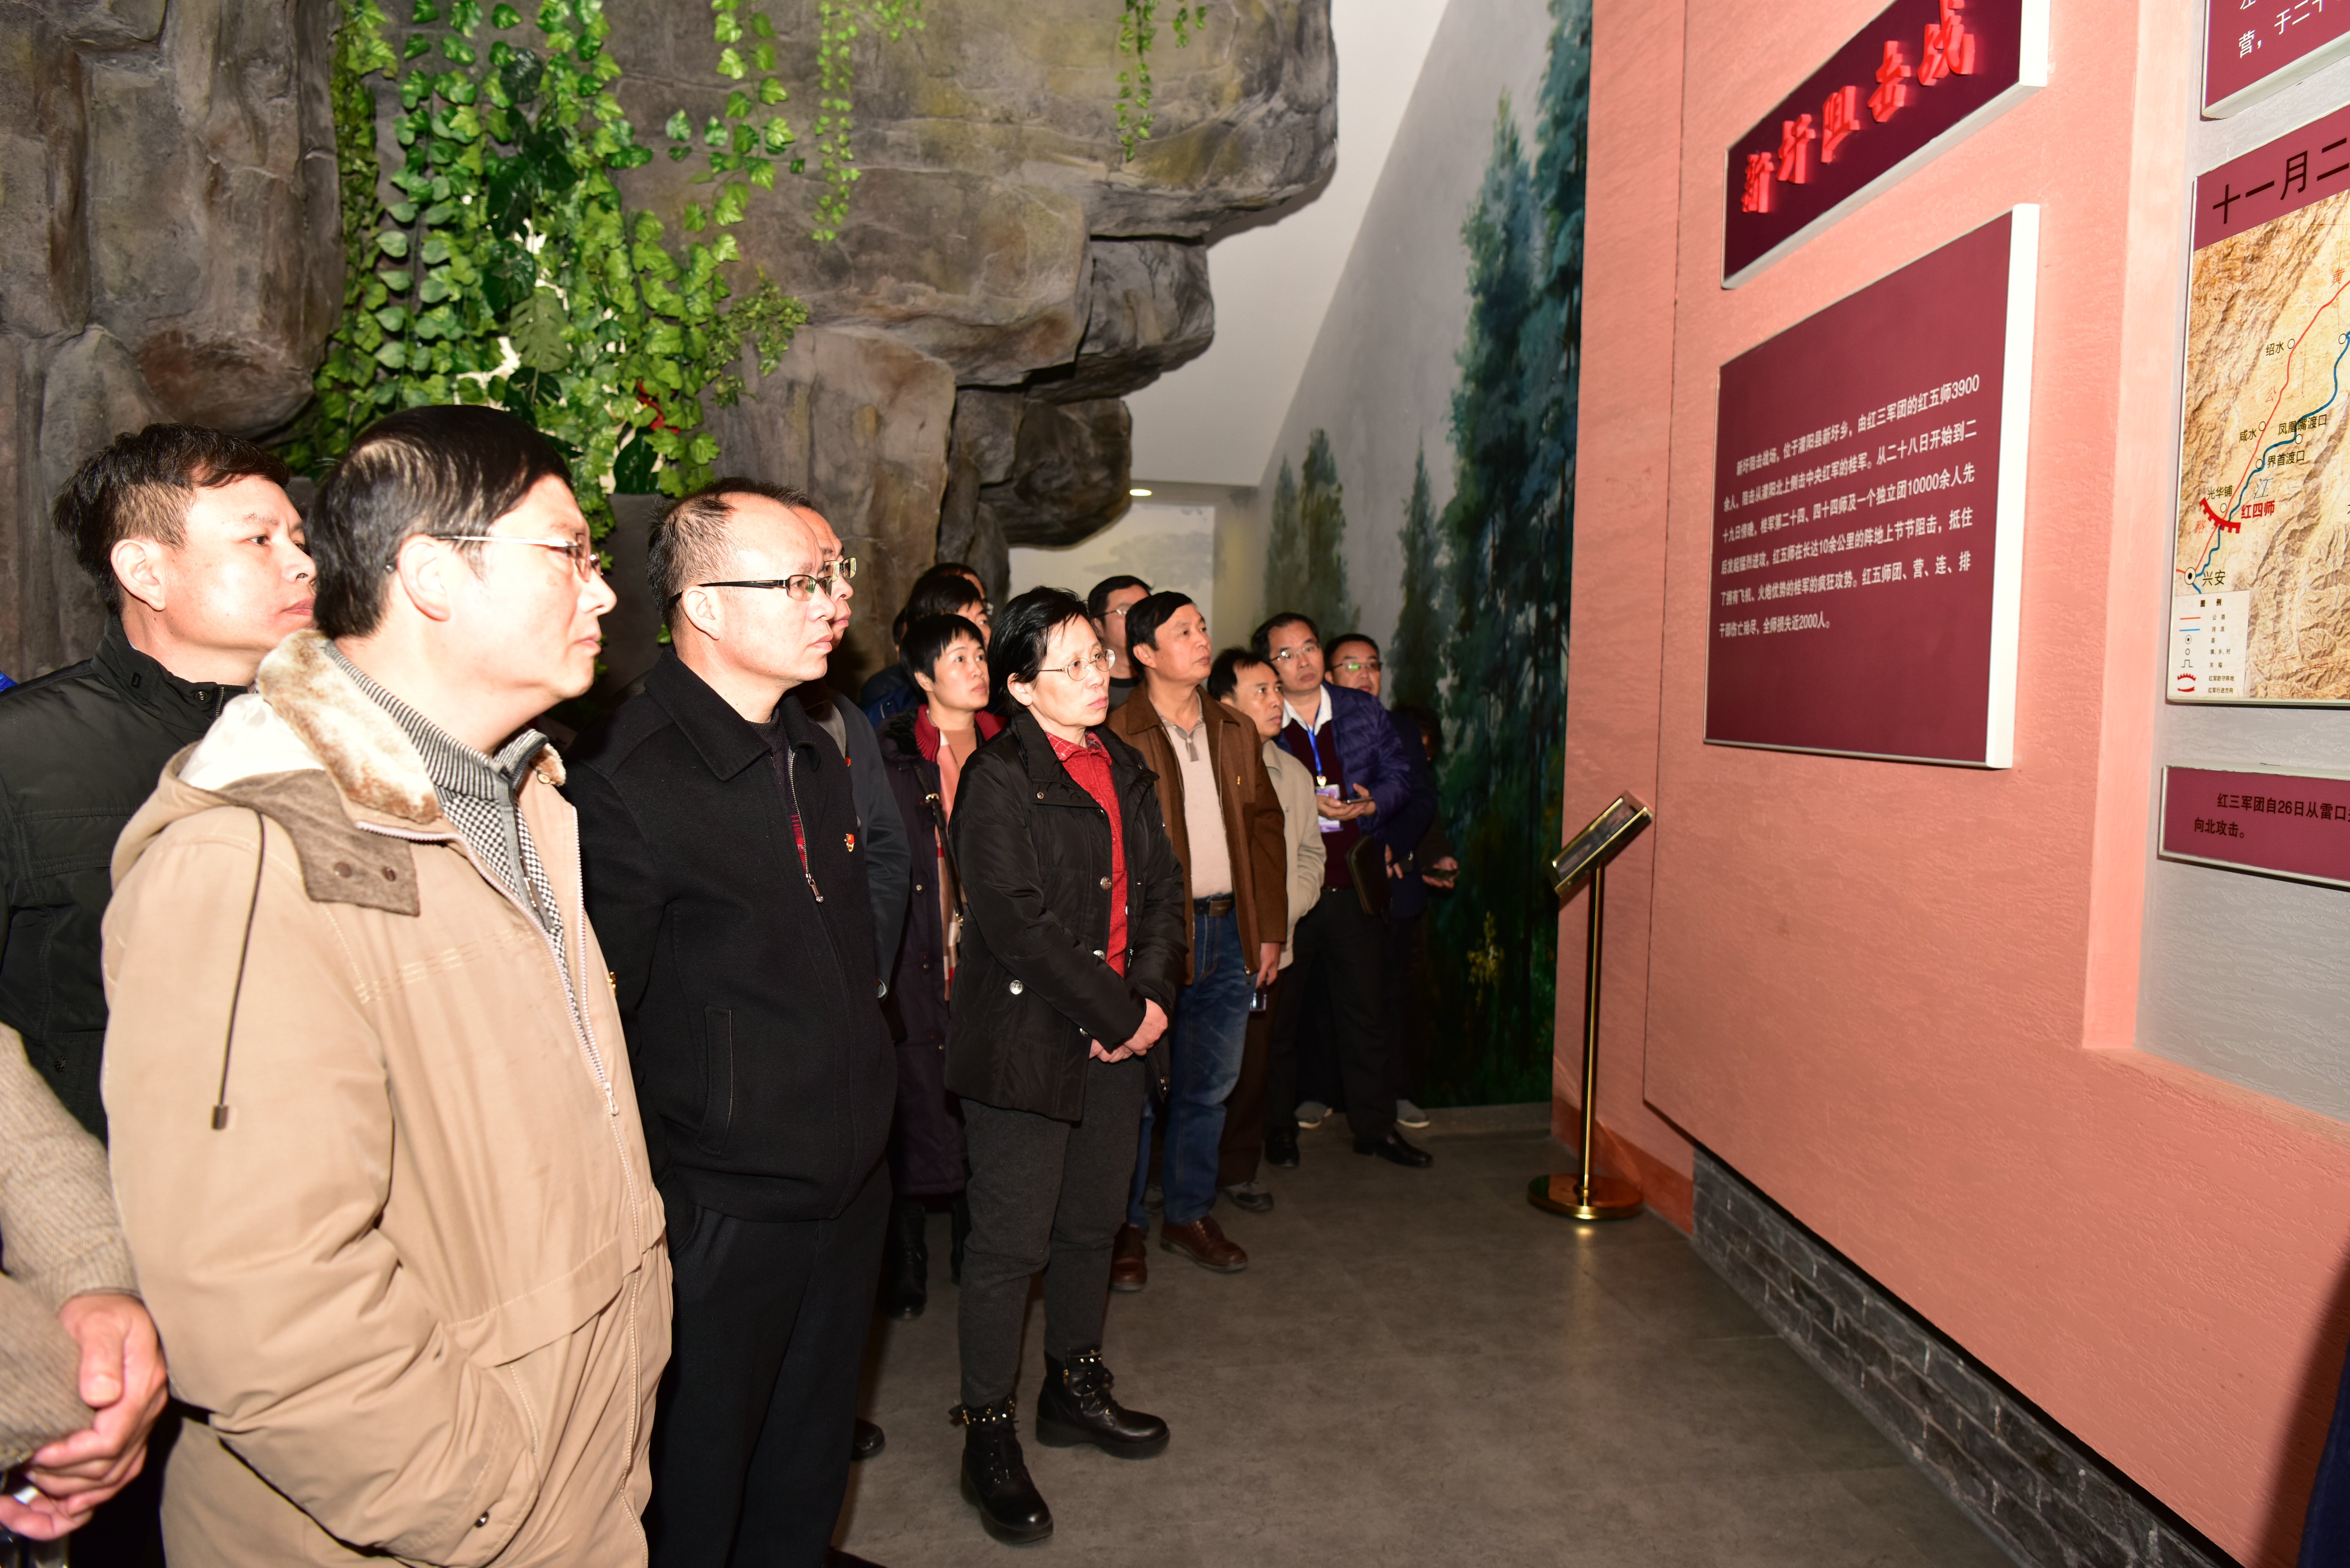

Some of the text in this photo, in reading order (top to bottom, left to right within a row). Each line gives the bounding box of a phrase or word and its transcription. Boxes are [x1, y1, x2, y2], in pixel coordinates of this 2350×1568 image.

[2213, 137, 2349, 224] 十一月二
[2329, 268, 2345, 288] 黄
[2265, 340, 2284, 356] 绍水
[2265, 386, 2277, 403] 公
[2278, 414, 2327, 435] 凤凰嘴渡口
[2239, 428, 2257, 442] 咸水
[2267, 450, 2305, 468] 界首渡口
[2207, 485, 2232, 500] 光华铺
[2253, 477, 2273, 499] 江
[2241, 500, 2275, 519] 红四师
[2194, 519, 2206, 534] 路
[2202, 570, 2225, 586] 兴安
[2194, 817, 2245, 839] 向北攻击。
